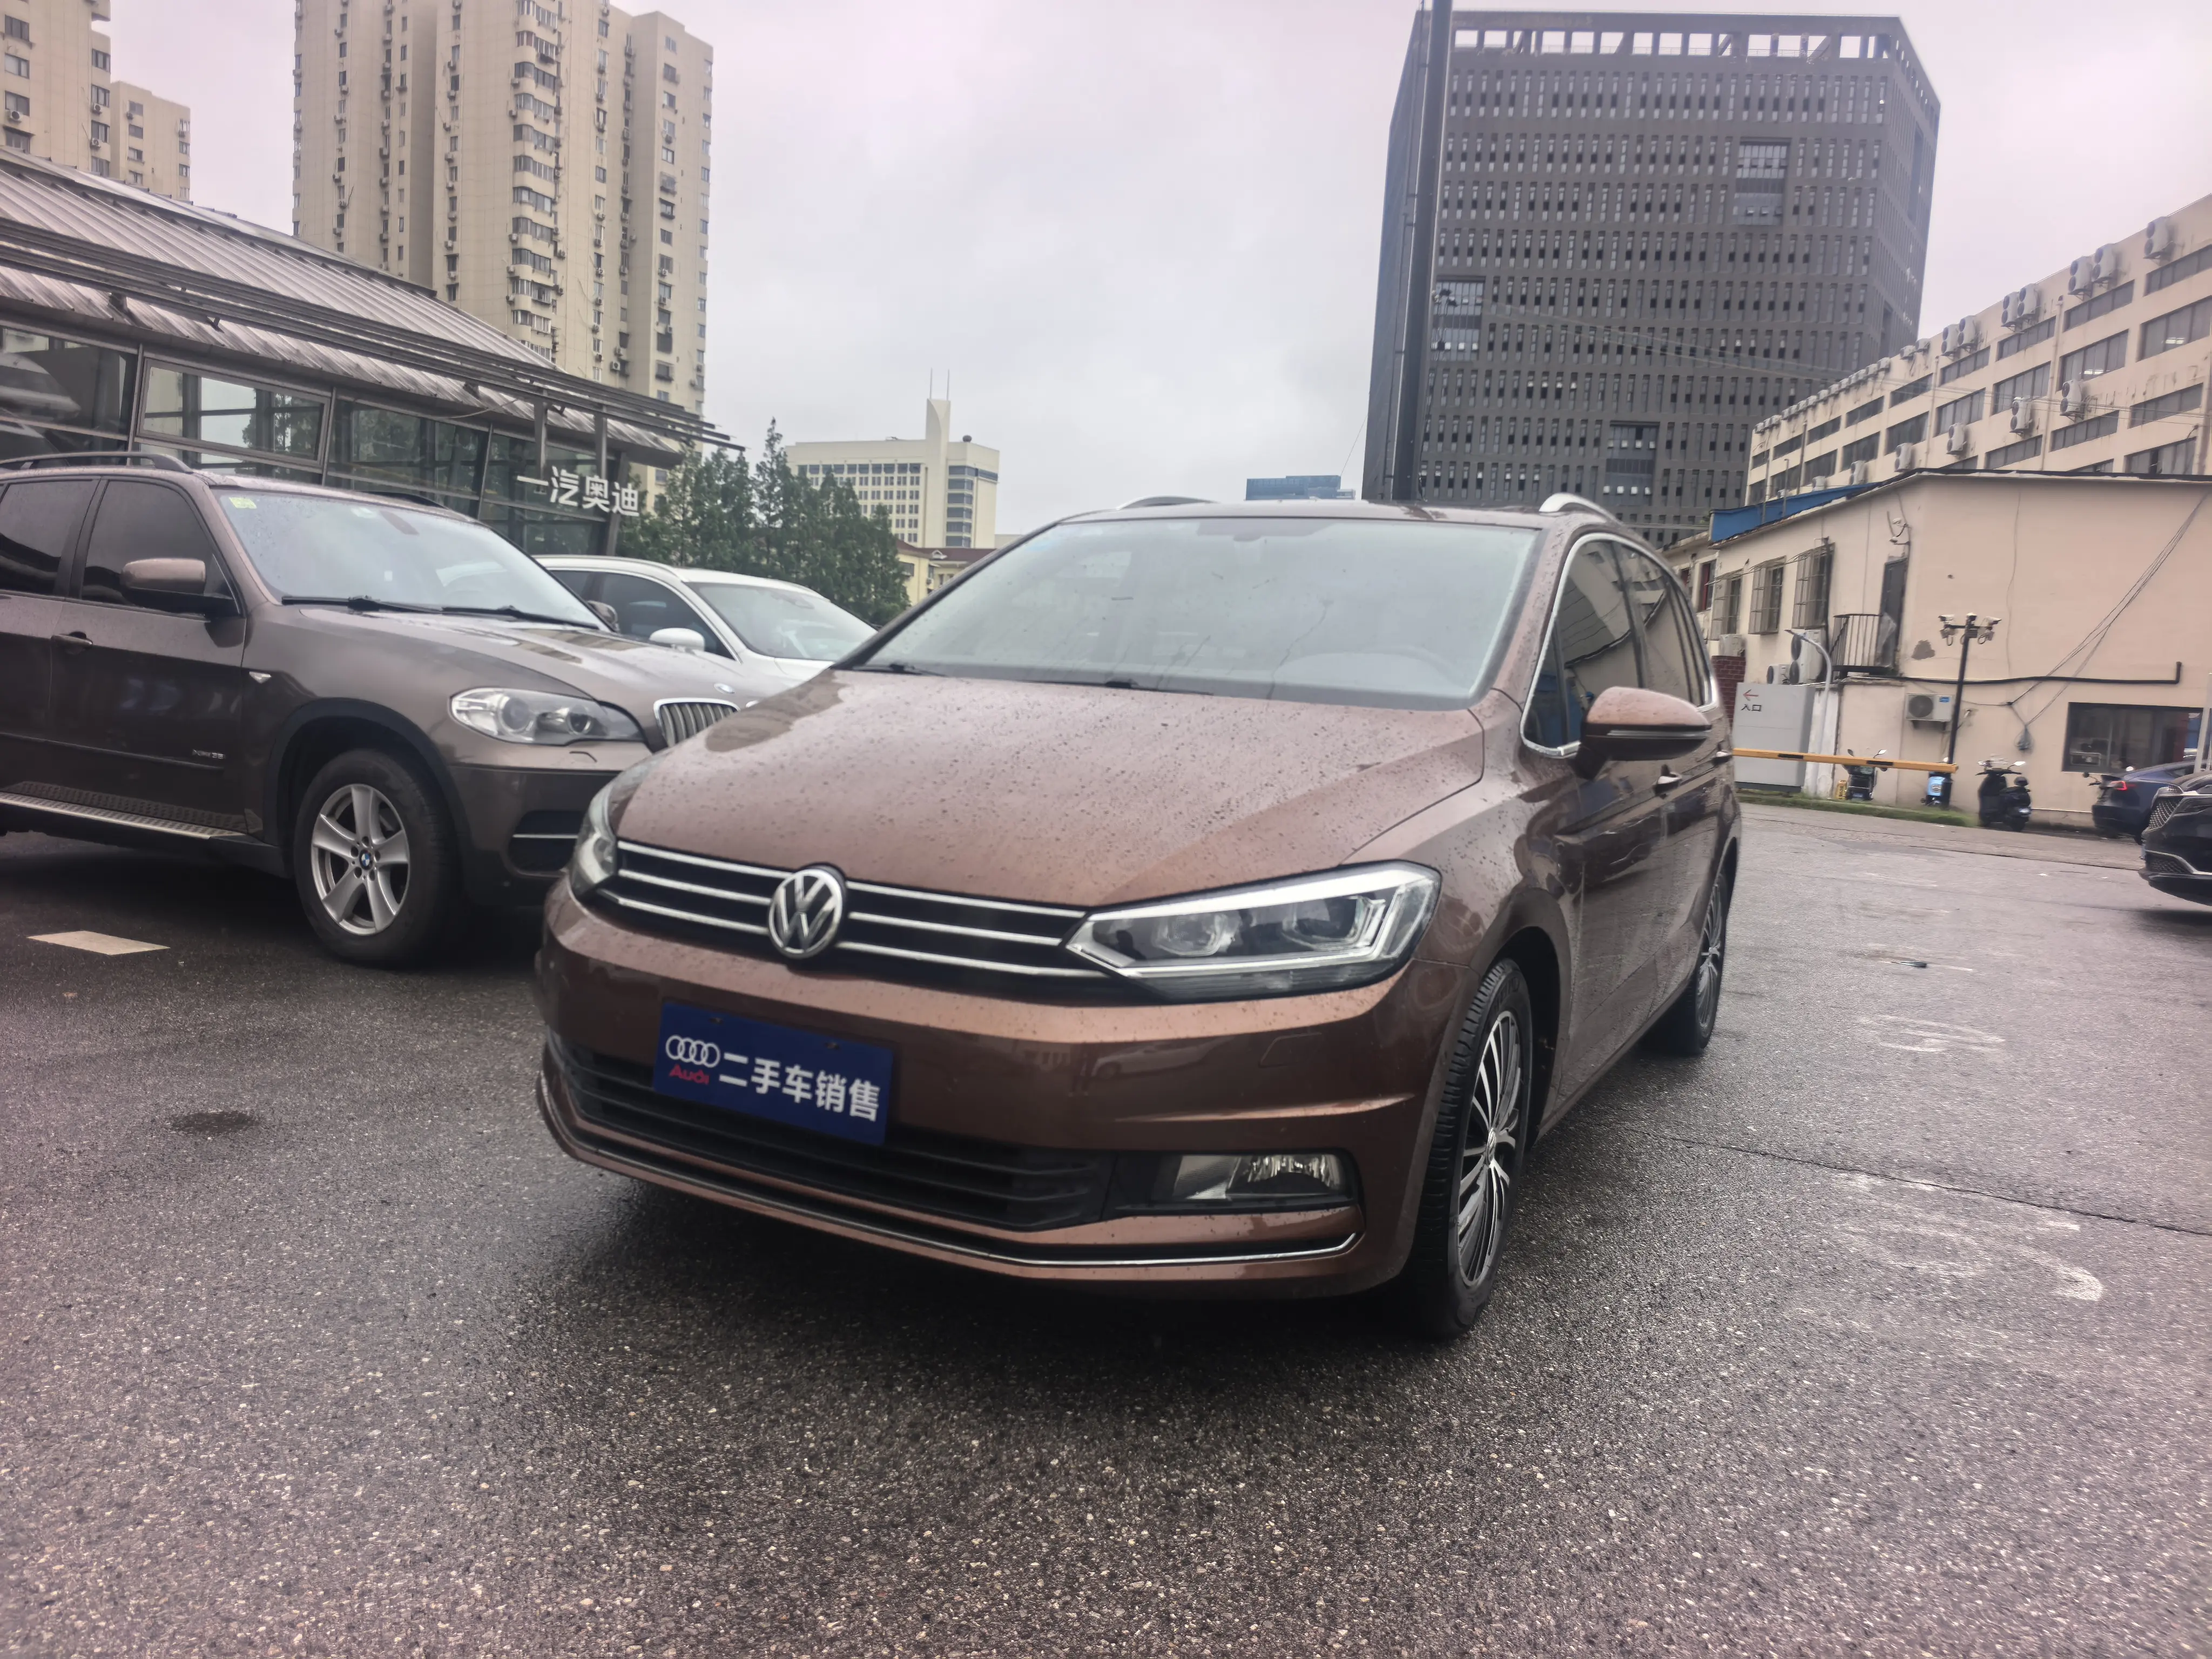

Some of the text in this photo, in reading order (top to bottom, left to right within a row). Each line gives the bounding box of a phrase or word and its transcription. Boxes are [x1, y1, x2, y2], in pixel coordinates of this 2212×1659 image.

[517, 466, 639, 516] 一汽奥迪
[669, 1064, 710, 1085] Audi
[719, 1053, 881, 1122] 二手车销售
